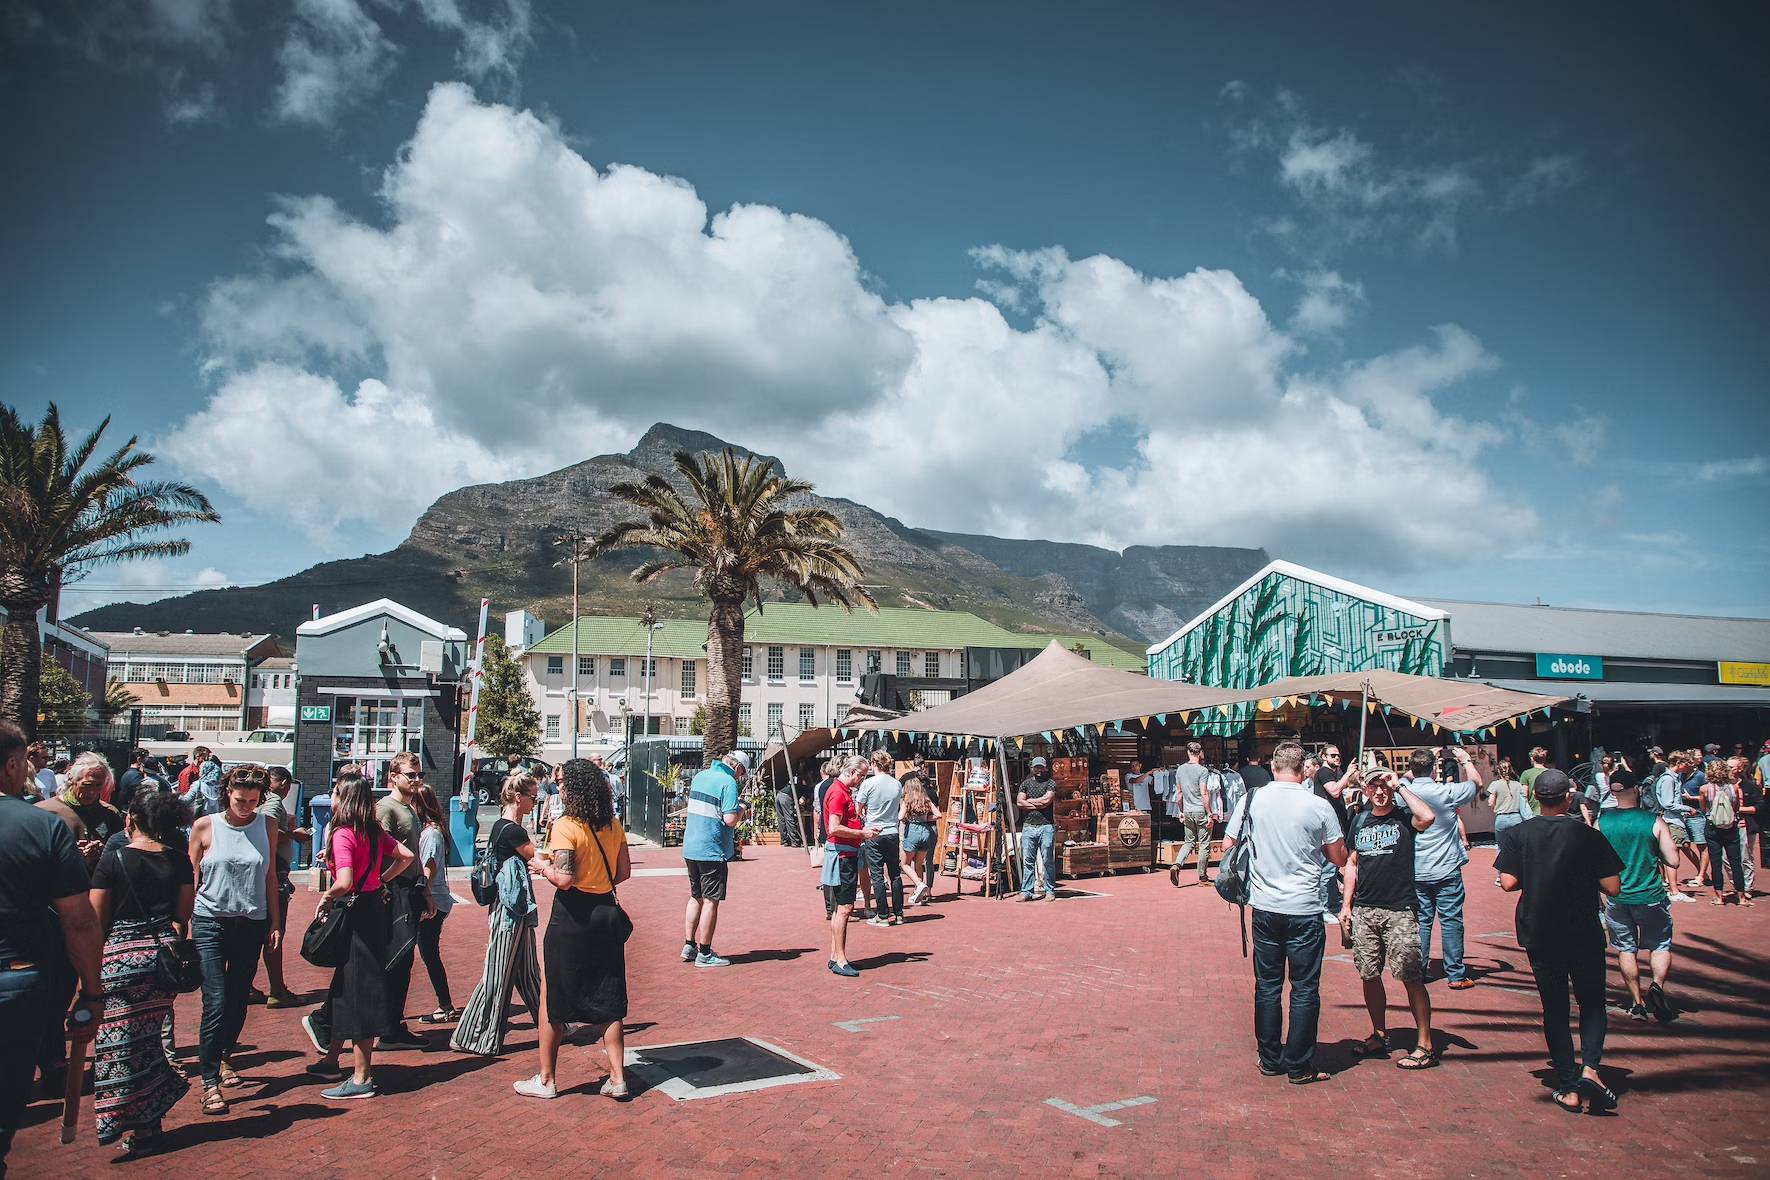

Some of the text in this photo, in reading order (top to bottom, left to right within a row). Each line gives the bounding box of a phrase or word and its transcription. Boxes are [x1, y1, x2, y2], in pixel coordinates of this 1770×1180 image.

[1377, 630, 1422, 641] E BLOCK
[1551, 658, 1590, 674] abode
